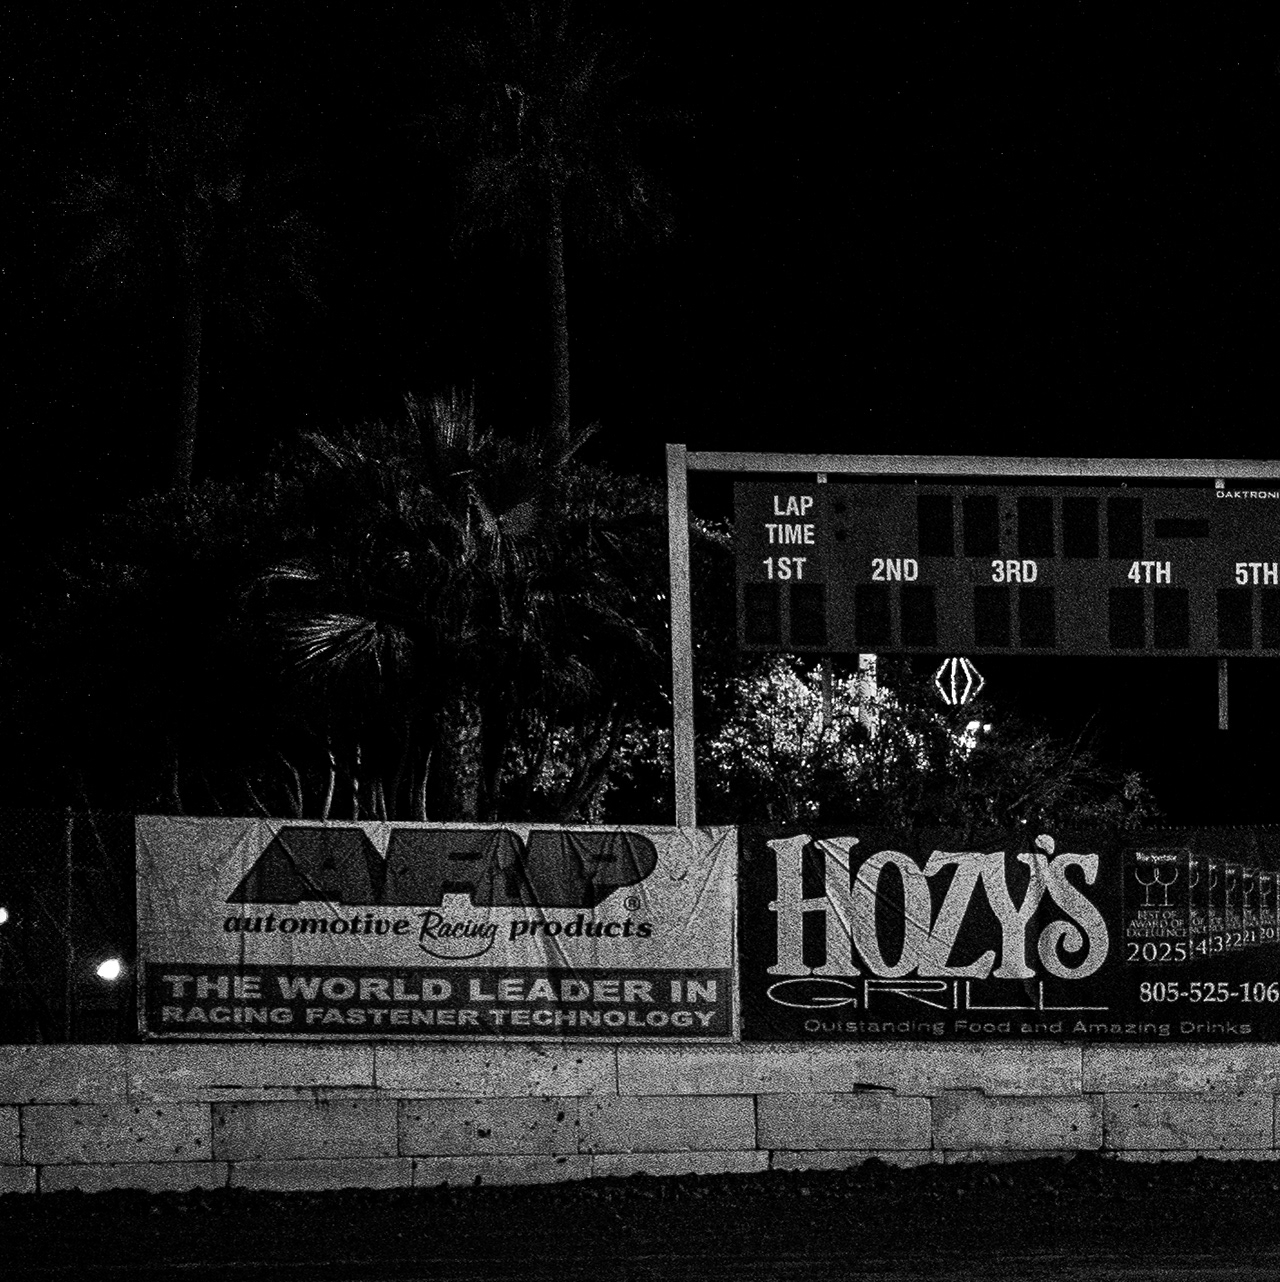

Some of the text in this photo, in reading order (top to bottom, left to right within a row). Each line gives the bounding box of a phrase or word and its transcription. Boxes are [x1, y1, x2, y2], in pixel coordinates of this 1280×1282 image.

[773, 494, 814, 517] LAP
[764, 522, 816, 546] TIME
[762, 556, 1279, 586] 1ST 2ND 3RD 4TH 5TH
[225, 825, 660, 909] ARP
[222, 909, 653, 942] automotive Racing products
[1129, 920, 1168, 929] AWARD
[1126, 941, 1188, 963] 2025
[162, 974, 718, 1003] THE WORLD LEADER IN
[767, 977, 1110, 1010] GRILL
[162, 1005, 717, 1029] RACING FASTENER TECHNOLOGY
[804, 1018, 1253, 1036] Outstanding Food and Amazing Drinks
